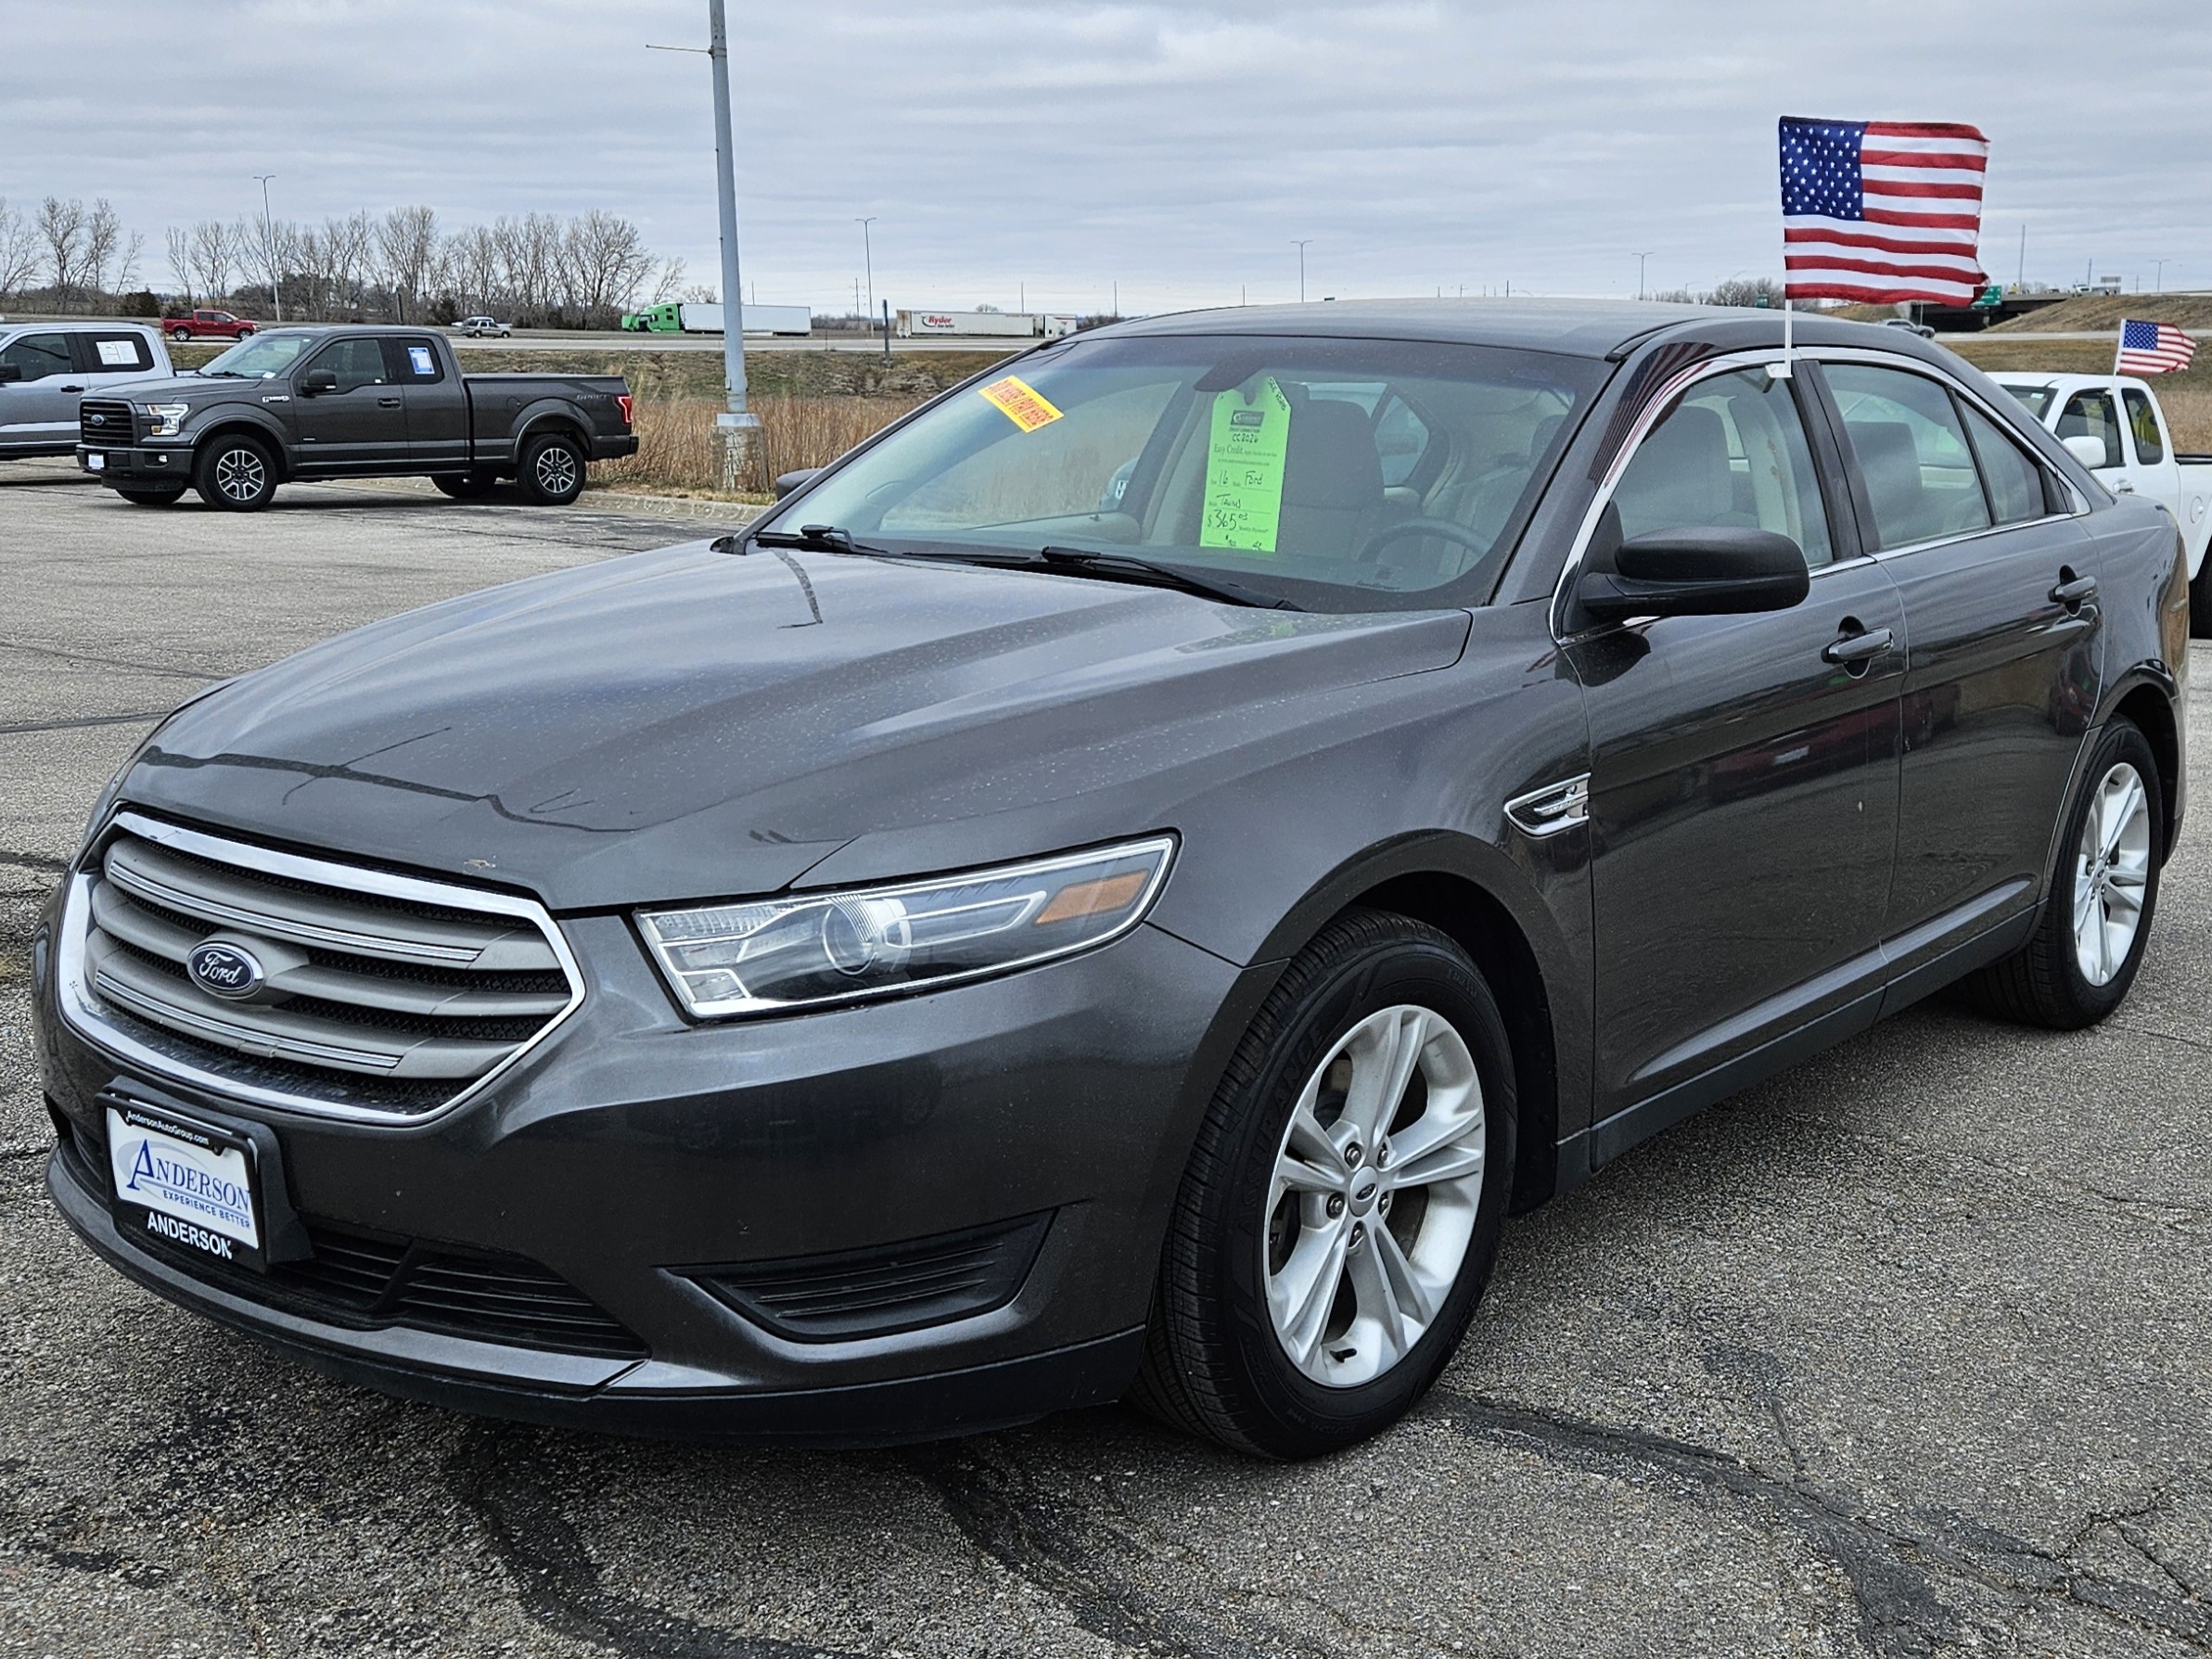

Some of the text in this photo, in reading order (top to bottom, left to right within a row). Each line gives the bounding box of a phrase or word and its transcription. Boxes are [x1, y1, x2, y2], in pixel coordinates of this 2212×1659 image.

[928, 315, 952, 325] Ryder
[1245, 470, 1263, 486] Ford
[198, 951, 243, 984] Ford
[125, 1111, 210, 1145] AndersonAutoGroup.com
[163, 1190, 250, 1229] EXPERIENCE BETTER
[147, 1211, 233, 1259] ANDERSON
